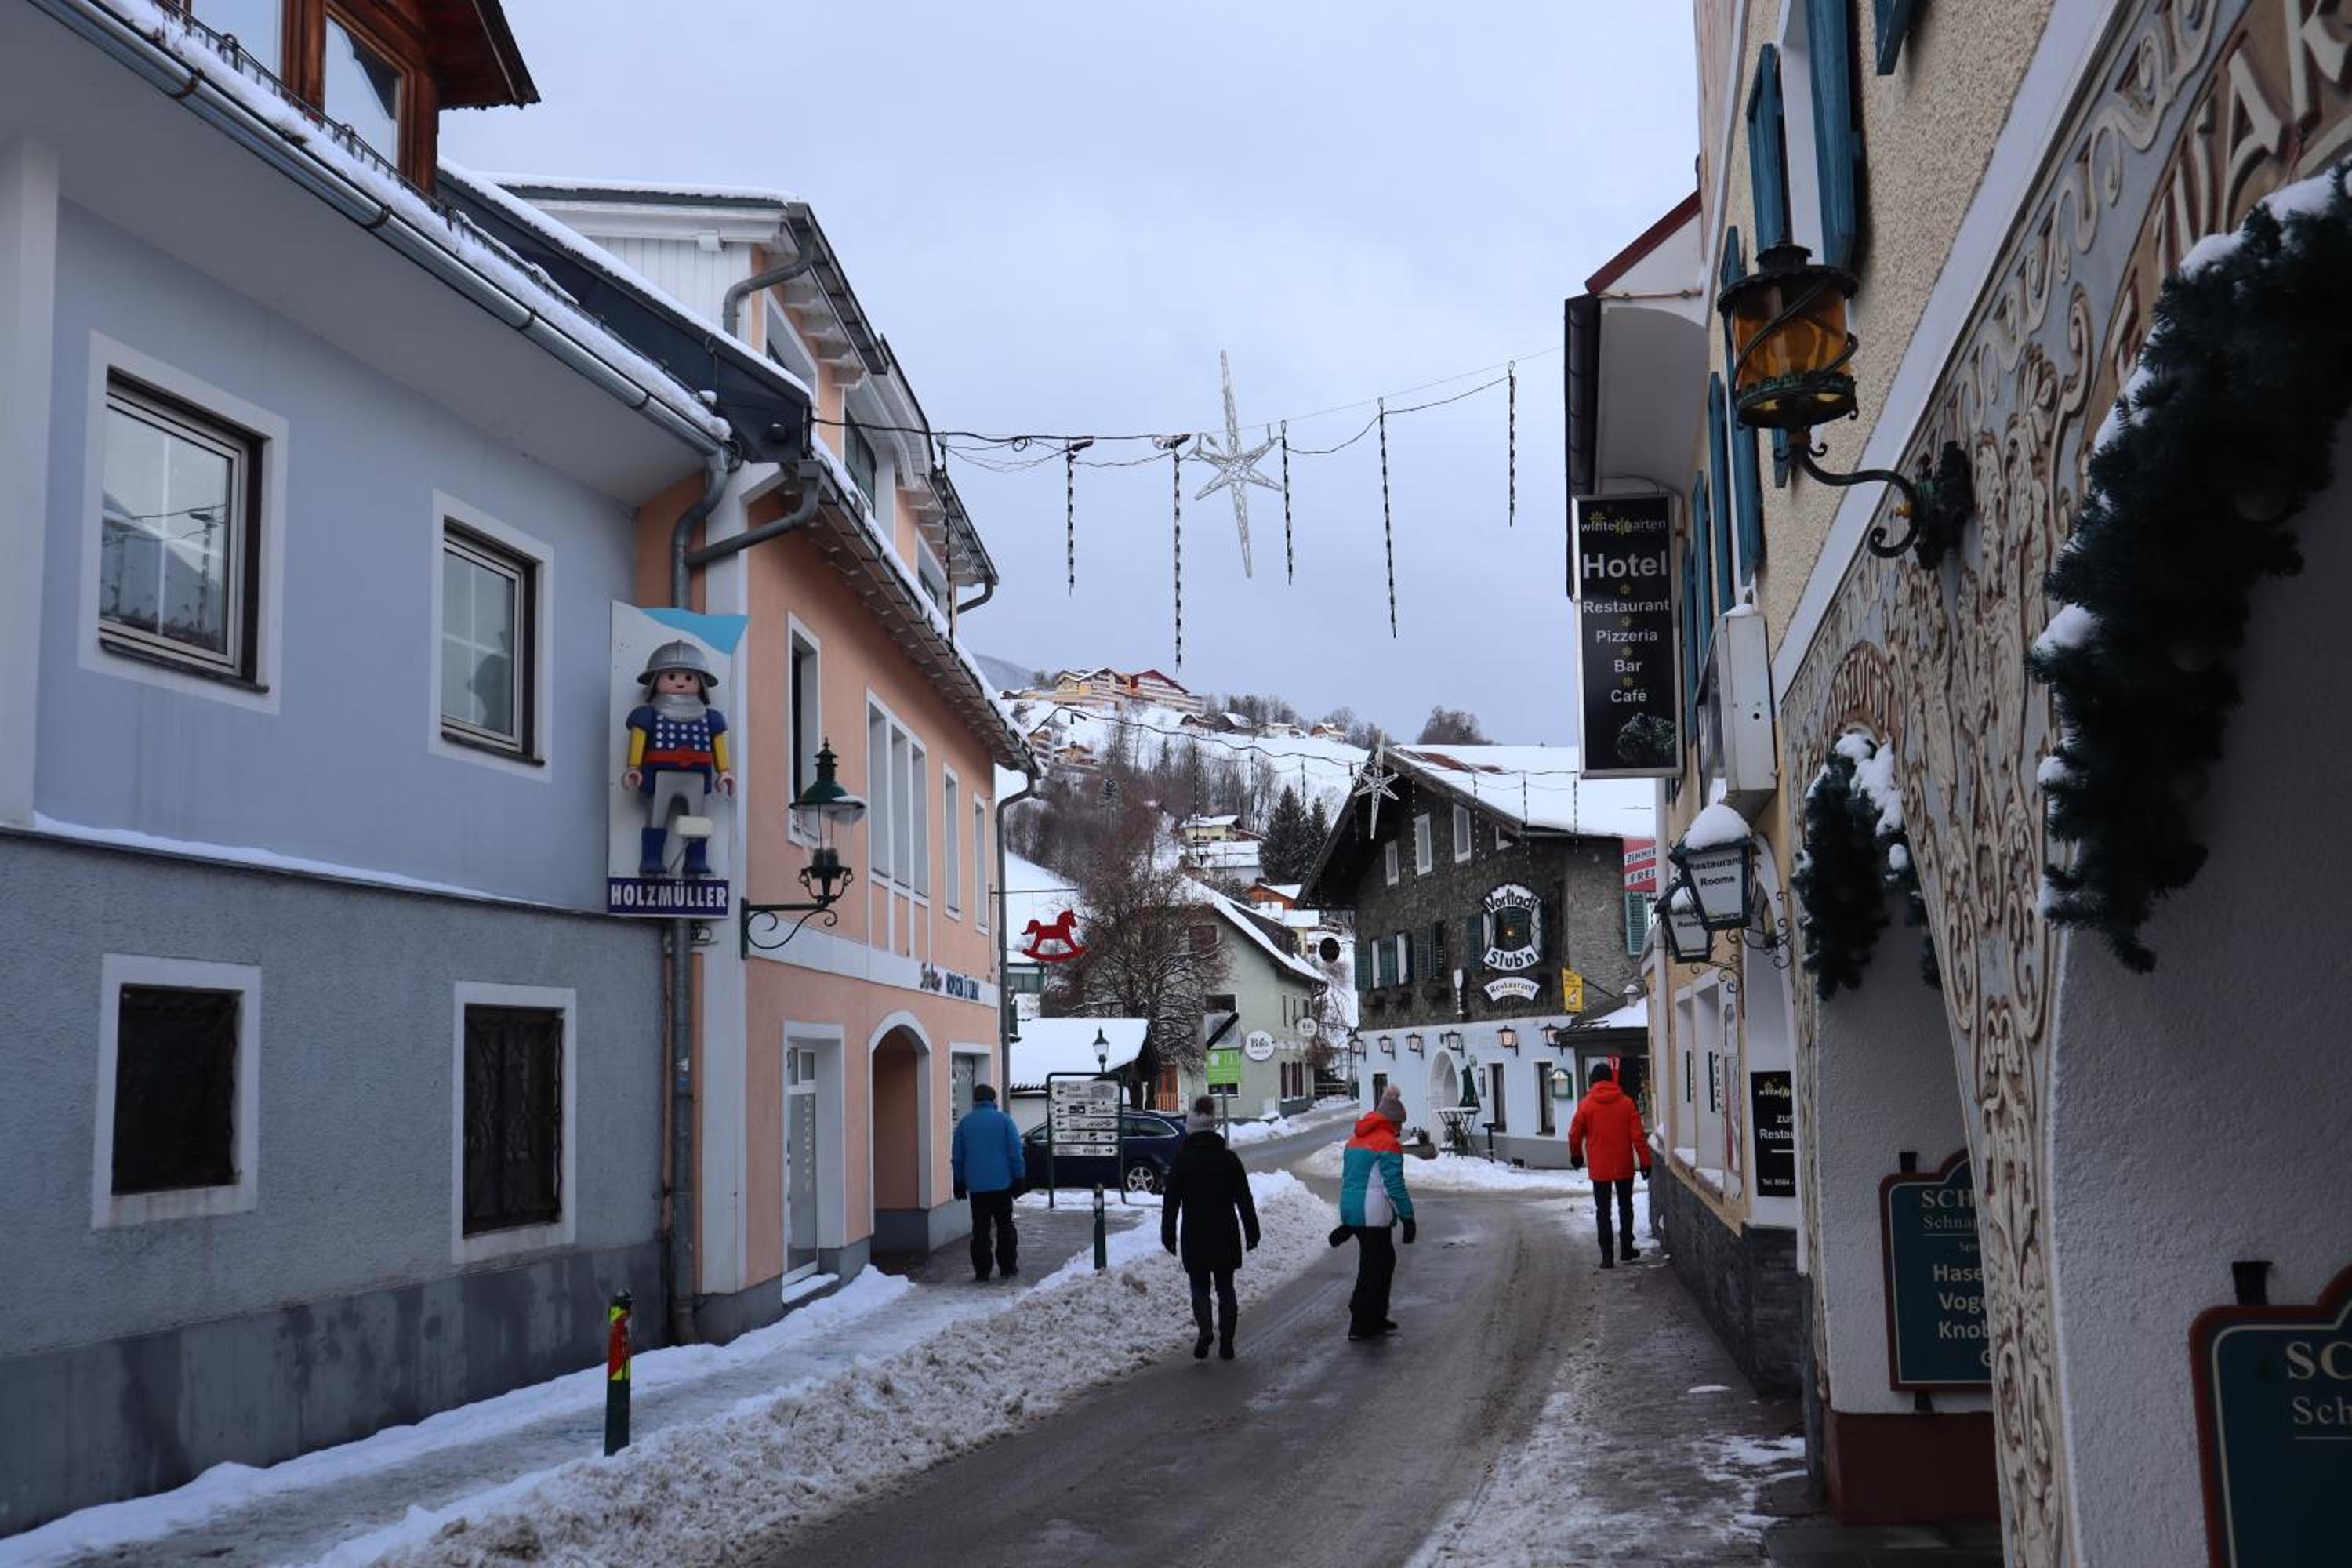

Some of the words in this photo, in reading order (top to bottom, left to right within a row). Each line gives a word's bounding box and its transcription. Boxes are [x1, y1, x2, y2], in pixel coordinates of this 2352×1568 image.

[1582, 551, 1667, 579] Hotel
[1583, 599, 1669, 615] Restaurant
[1596, 630, 1657, 643] Pizzeria
[1614, 660, 1642, 672] Bar
[1610, 689, 1647, 702] Café
[611, 881, 726, 907] HOLZMÜLLER
